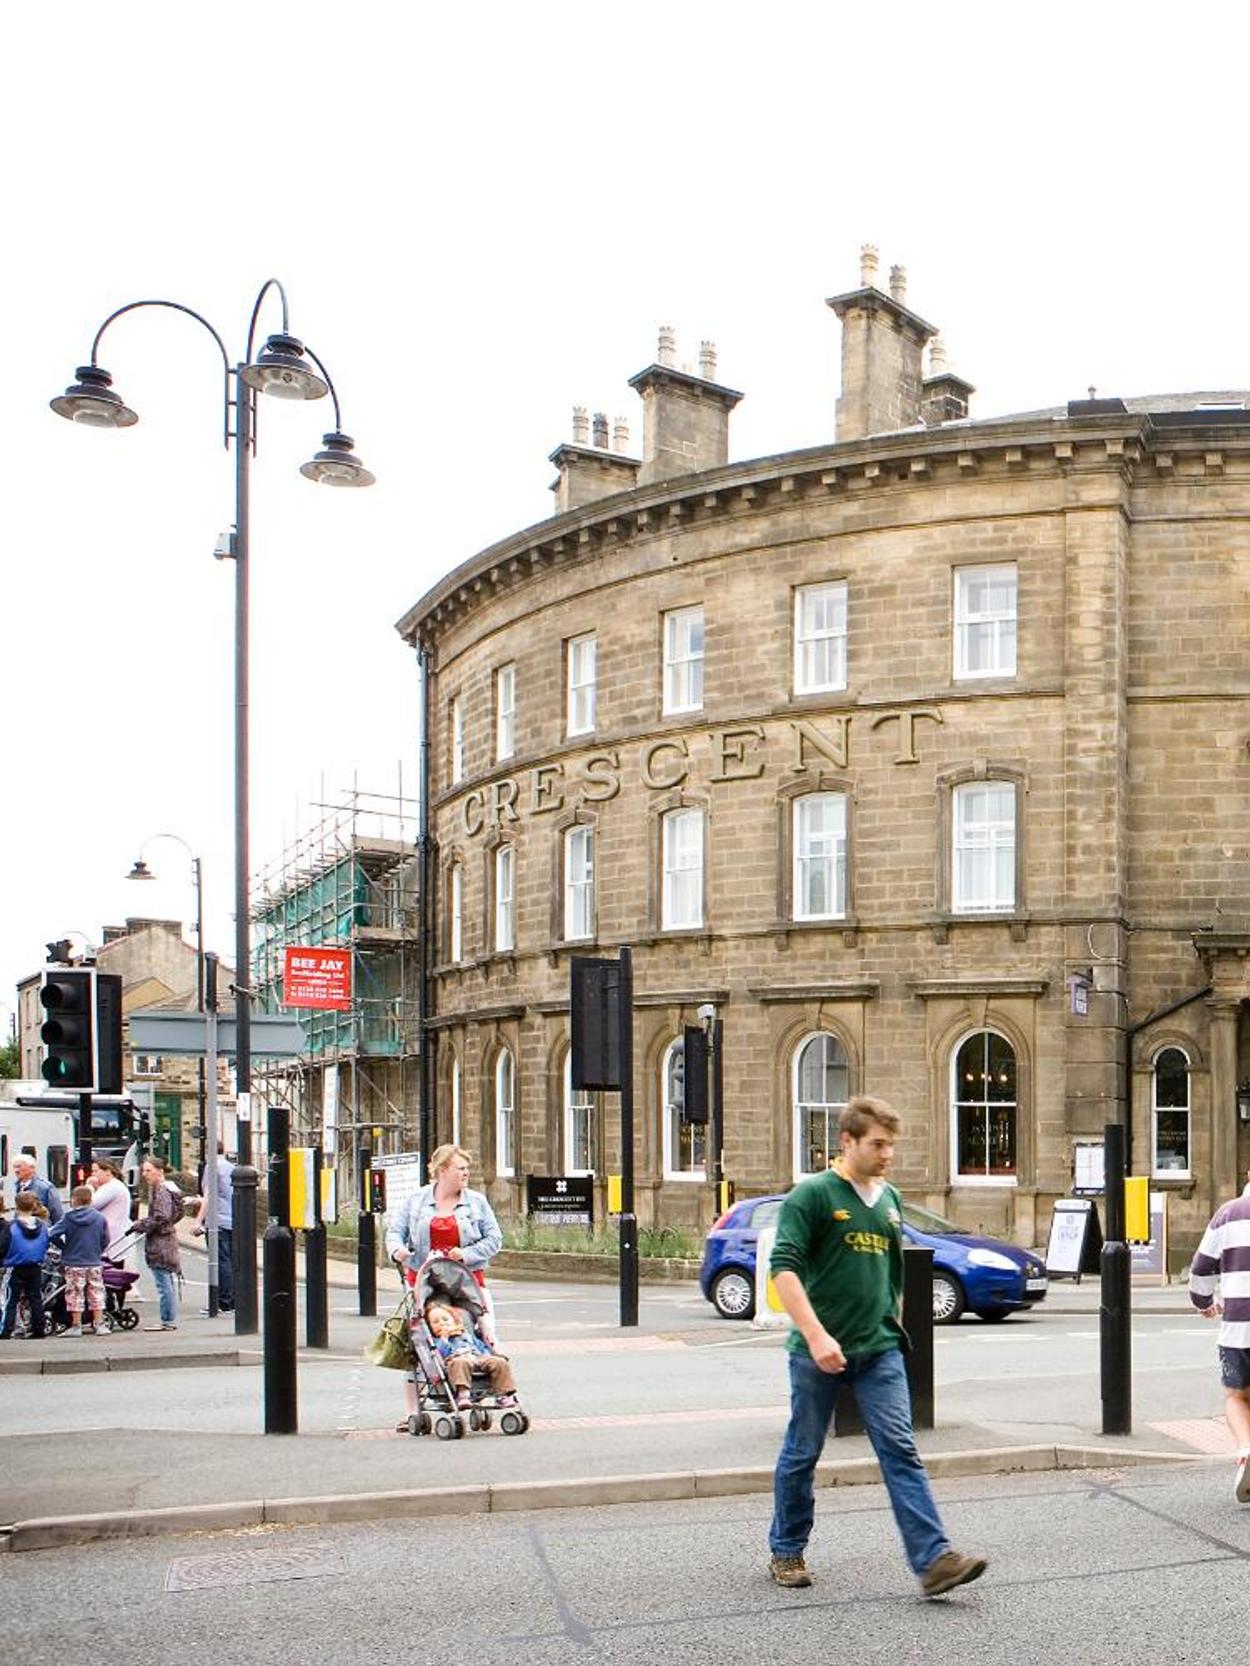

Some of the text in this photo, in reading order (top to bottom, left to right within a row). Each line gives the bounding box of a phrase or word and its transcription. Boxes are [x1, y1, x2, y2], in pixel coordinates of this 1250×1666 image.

[461, 707, 944, 838] CRESCENT
[291, 957, 344, 970] BEE JAY
